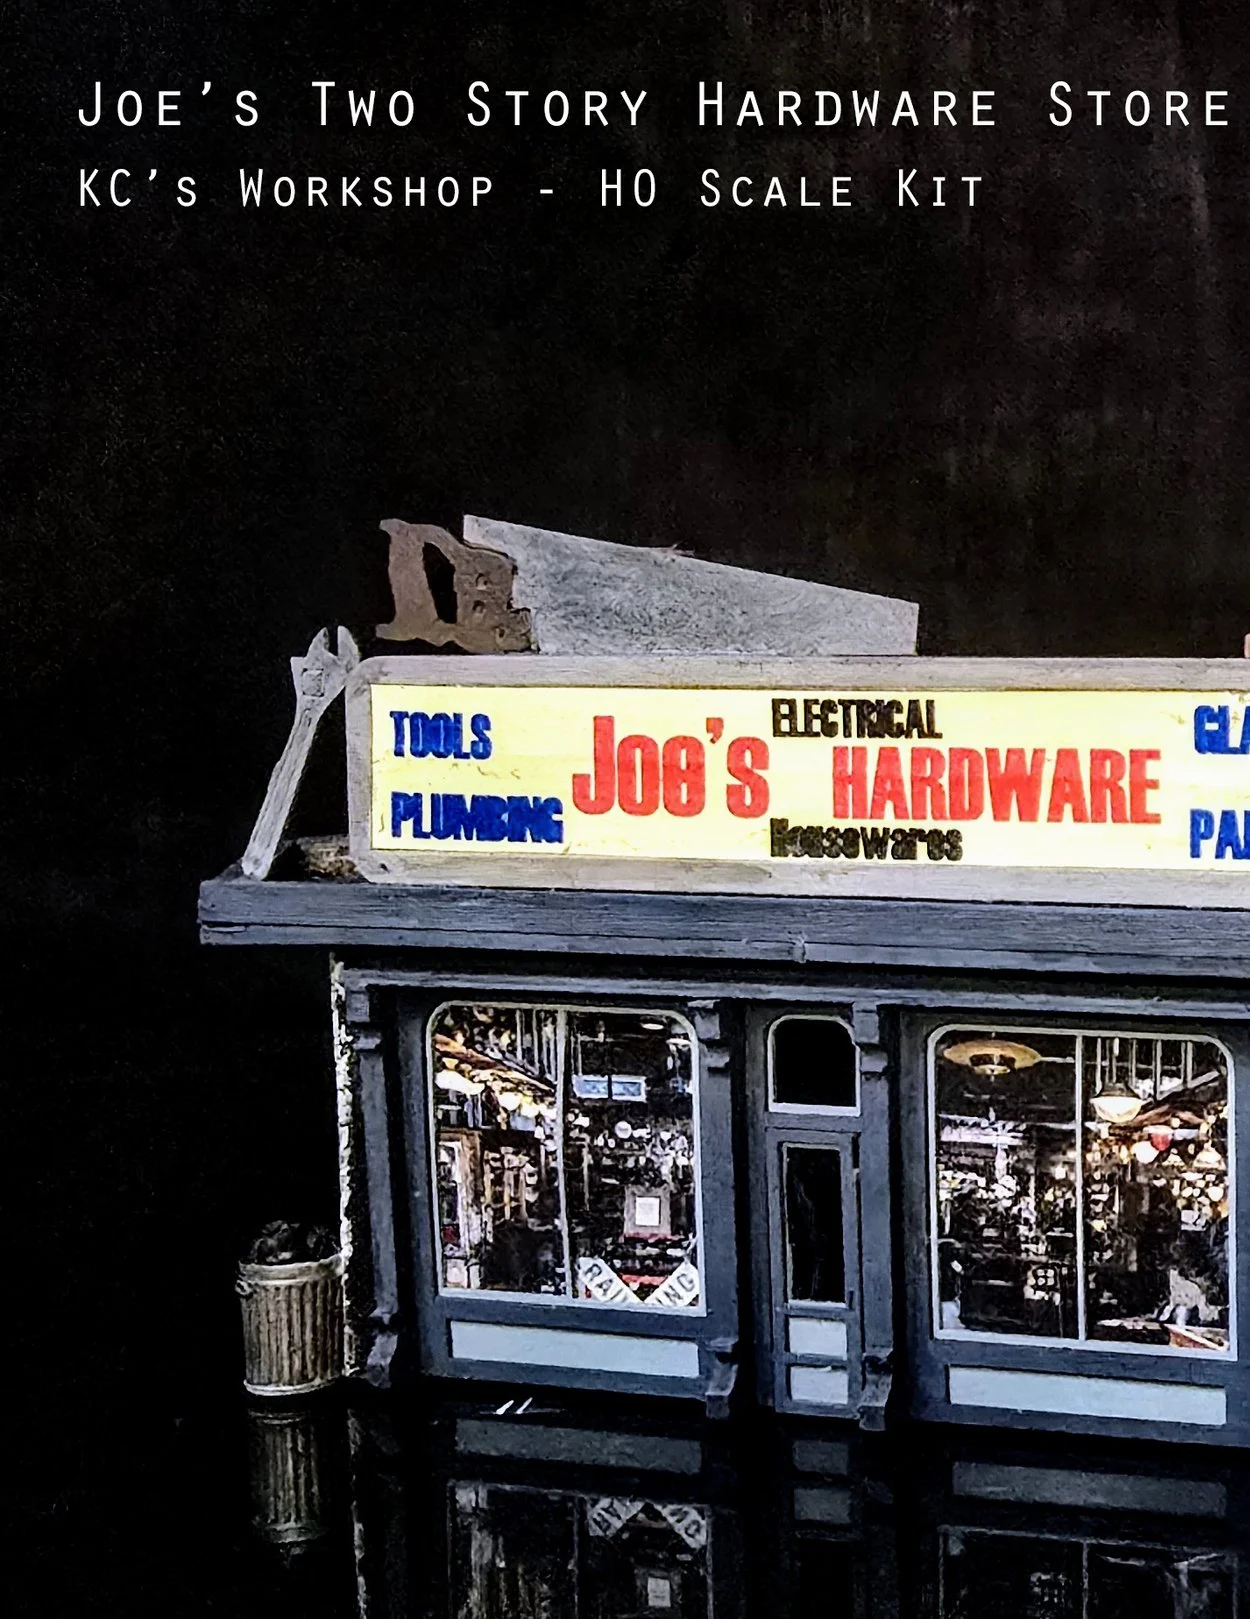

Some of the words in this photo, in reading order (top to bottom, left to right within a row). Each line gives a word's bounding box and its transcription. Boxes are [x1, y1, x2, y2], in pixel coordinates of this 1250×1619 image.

[390, 711, 494, 761] TOOLS
[771, 698, 944, 740] ELECTRICAL
[832, 745, 1162, 826] HARDWARE
[391, 792, 565, 846] PLUMBING
